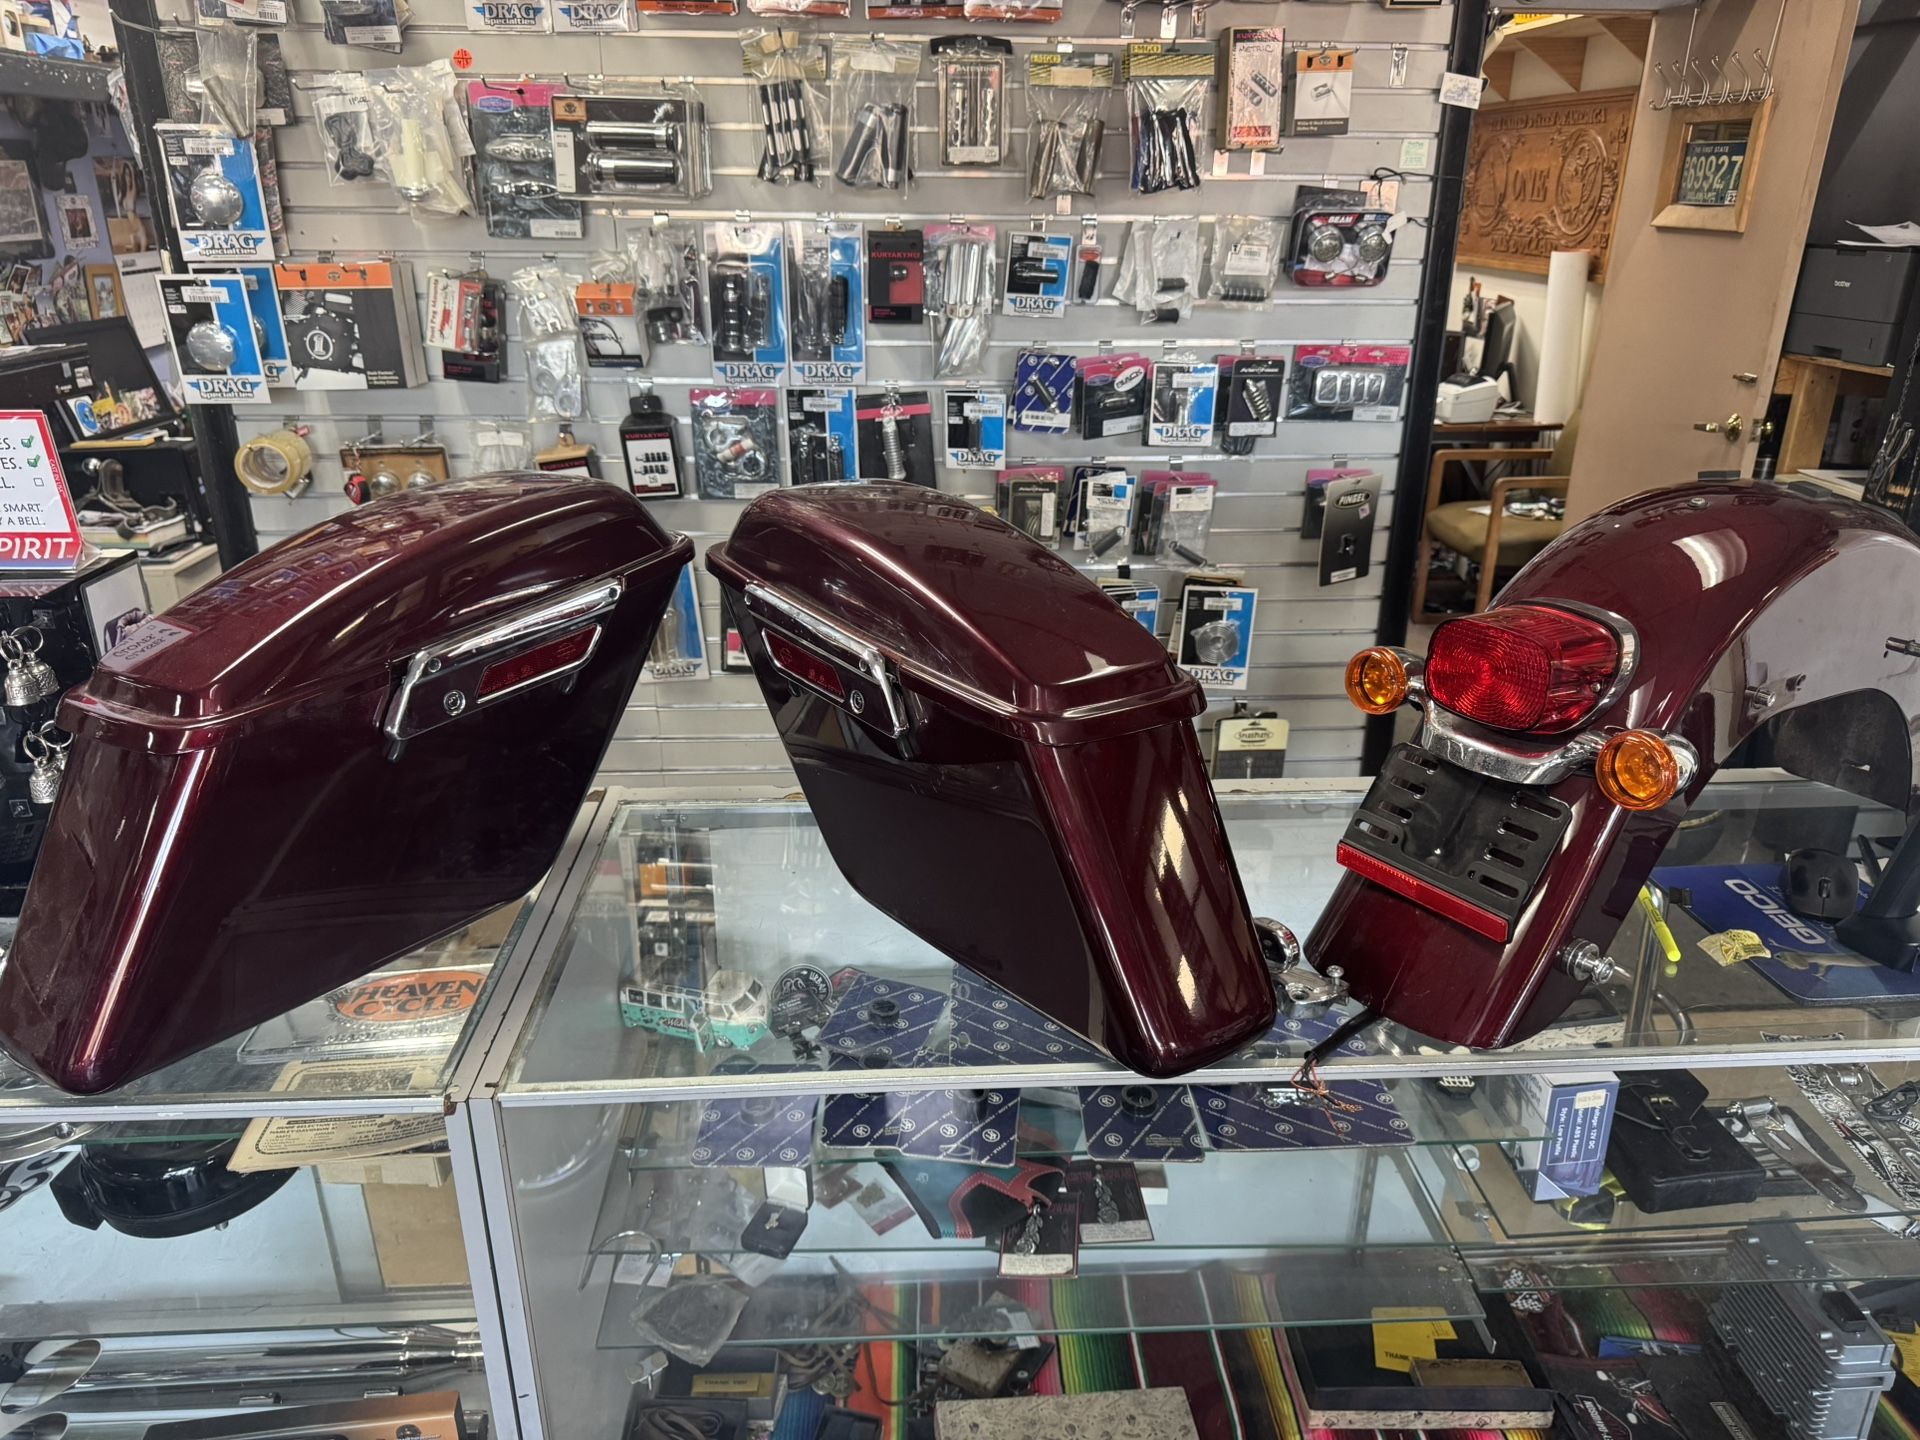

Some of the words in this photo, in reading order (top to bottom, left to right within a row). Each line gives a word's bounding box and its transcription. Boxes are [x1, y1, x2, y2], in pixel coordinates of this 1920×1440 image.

[484, 3, 536, 18] DRAG
[484, 17, 536, 26] Specialties
[1714, 145, 1729, 153] STATE
[196, 233, 256, 249] DRAG
[199, 247, 257, 256] Specialties
[1015, 296, 1055, 309] DRAG
[724, 363, 776, 378] DRAG
[801, 363, 854, 378] DRAG
[198, 378, 253, 392] DRAG
[1115, 369, 1144, 390] BLACK
[200, 390, 255, 399] Specialties
[1162, 425, 1201, 438] DRAG
[956, 451, 995, 463] DRAG
[3, 503, 43, 513] SMART.
[7, 516, 15, 526] A
[18, 516, 46, 526] BELL.
[1189, 668, 1234, 682] DRAG
[1723, 879, 1827, 945] GEICO
[350, 978, 482, 1004] HEAVEN
[353, 994, 462, 1016] CYCLE
[1559, 1106, 1569, 1124] Style:
[1557, 1124, 1566, 1137] Low
[1573, 1125, 1582, 1138] ABS
[1589, 1126, 1599, 1140] 12V
[1554, 1136, 1564, 1156] Profile
[1570, 1138, 1580, 1159] Plastic
[1587, 1139, 1596, 1150] DC
